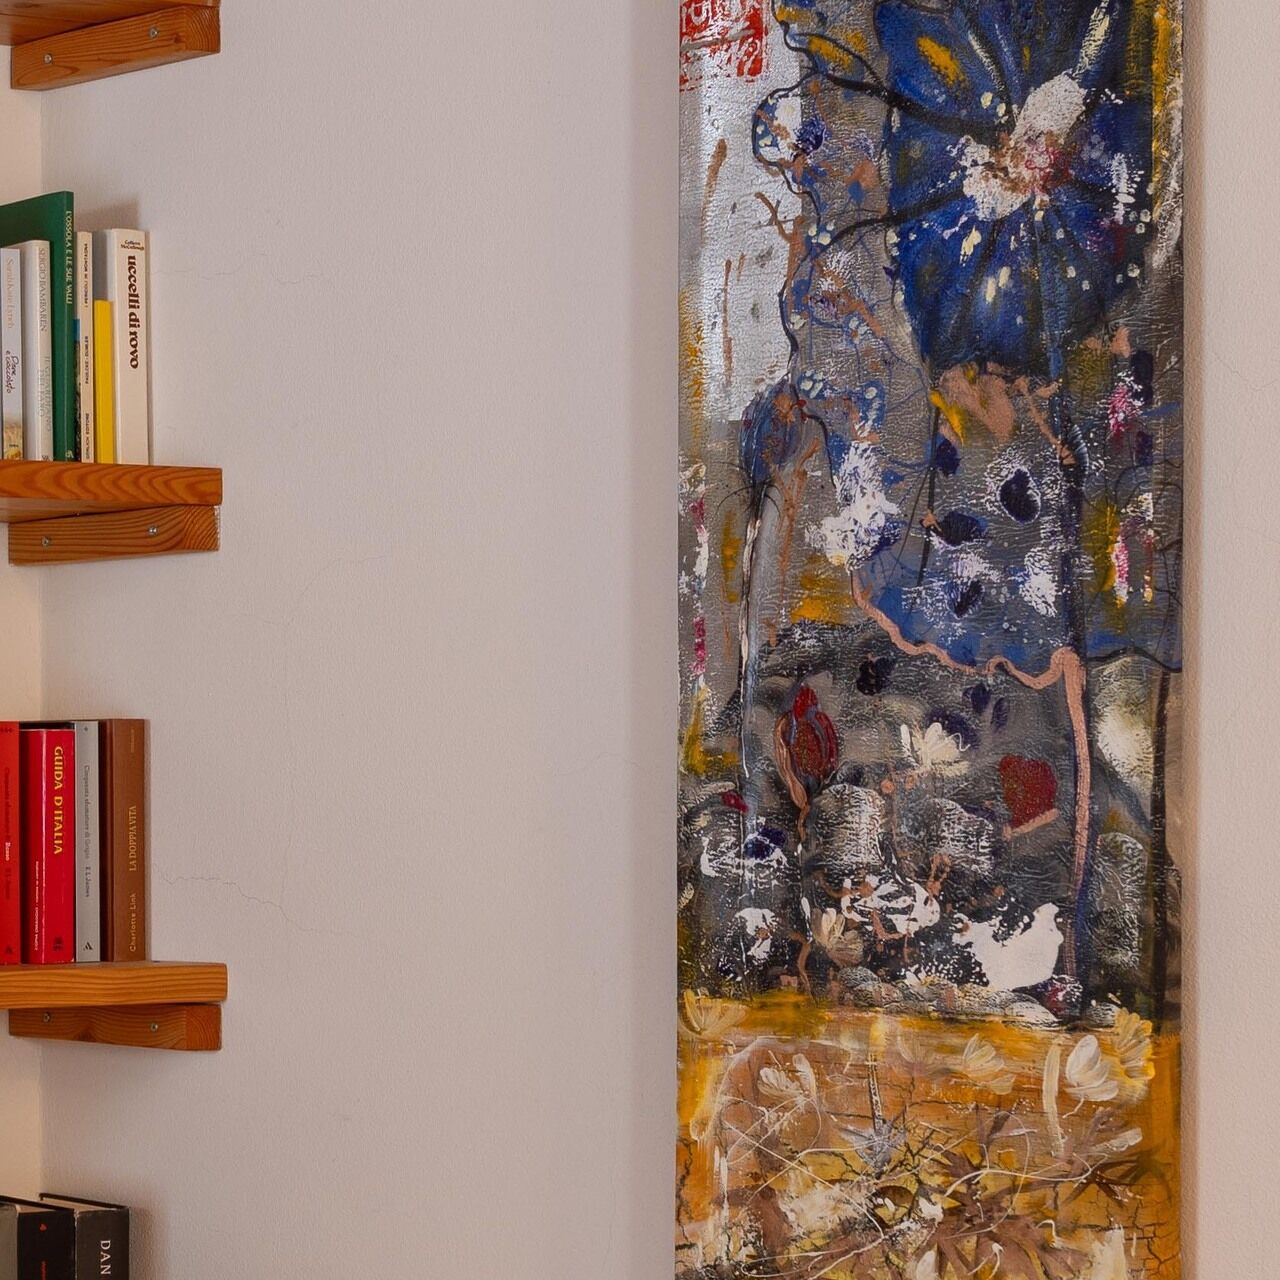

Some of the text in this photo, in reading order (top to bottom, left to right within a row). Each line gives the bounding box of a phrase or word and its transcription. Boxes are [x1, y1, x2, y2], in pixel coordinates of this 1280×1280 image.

[128, 255, 141, 369] uccelli di rovo
[53, 746, 64, 855] GUIDA D'ITALIA
[129, 805, 137, 872] LA DOPPIA VITA
[129, 893, 137, 953] Charlotte Link
[100, 1240, 112, 1276] DAN
